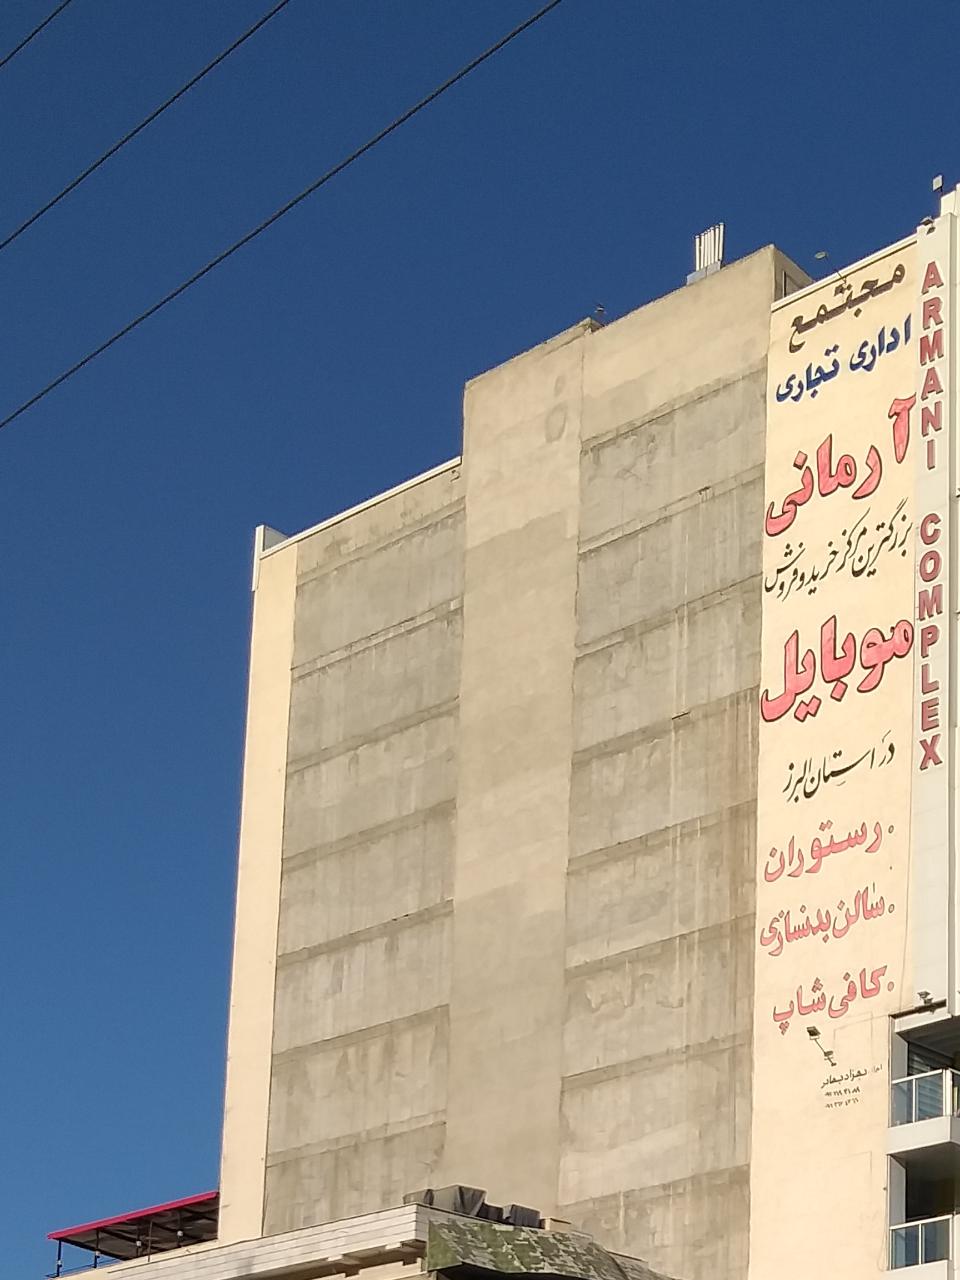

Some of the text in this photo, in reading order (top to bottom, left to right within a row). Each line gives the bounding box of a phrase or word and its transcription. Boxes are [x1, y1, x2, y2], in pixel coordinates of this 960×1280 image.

[788, 263, 906, 354] مجتمع
[775, 312, 913, 403] اداری تجاری
[764, 391, 917, 537] آرمانی
[918, 260, 944, 771] ARMANI COMPLEX
[760, 613, 914, 723] موبایل
[763, 819, 883, 883] رستوران
[759, 882, 886, 957] سالن بدنسازی
[772, 964, 888, 1036] کافی شاپ
